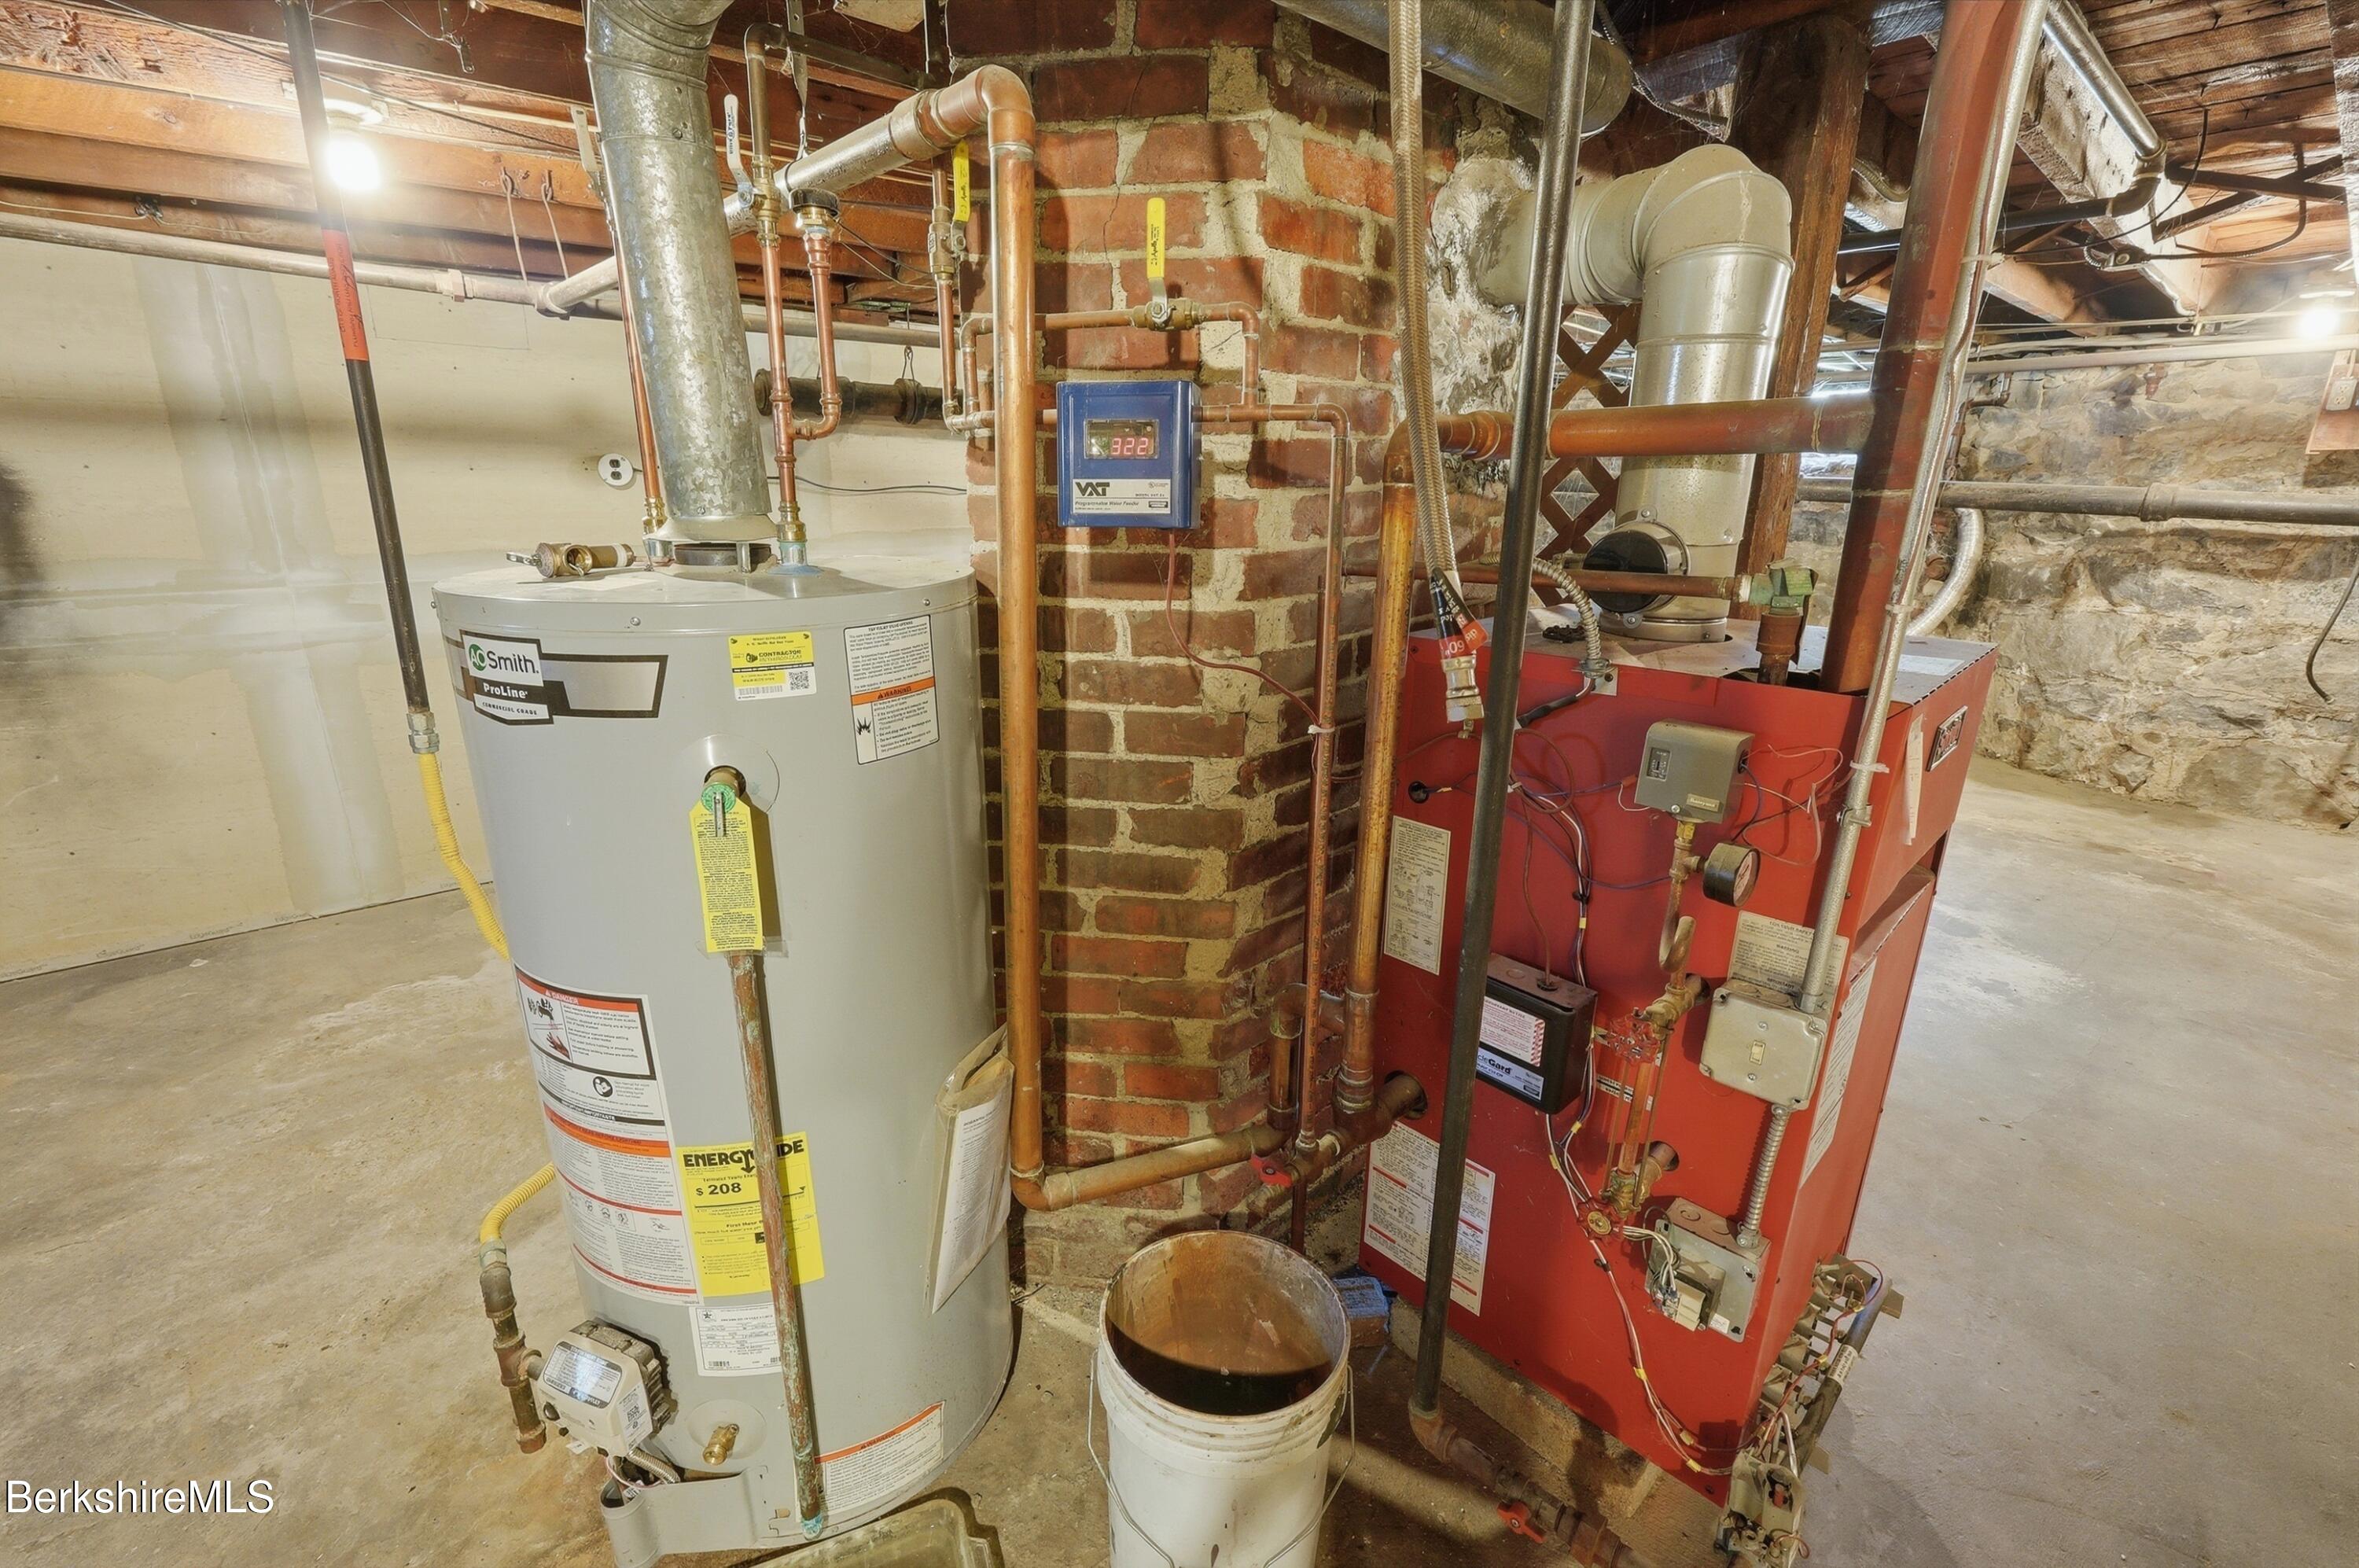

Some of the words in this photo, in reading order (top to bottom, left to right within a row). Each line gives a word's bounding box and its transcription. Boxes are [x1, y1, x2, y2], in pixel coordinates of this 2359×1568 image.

[1110, 436, 1150, 456] 322
[483, 682, 524, 698] ProLine
[696, 1187, 704, 1196] $
[708, 1182, 742, 1195] 208
